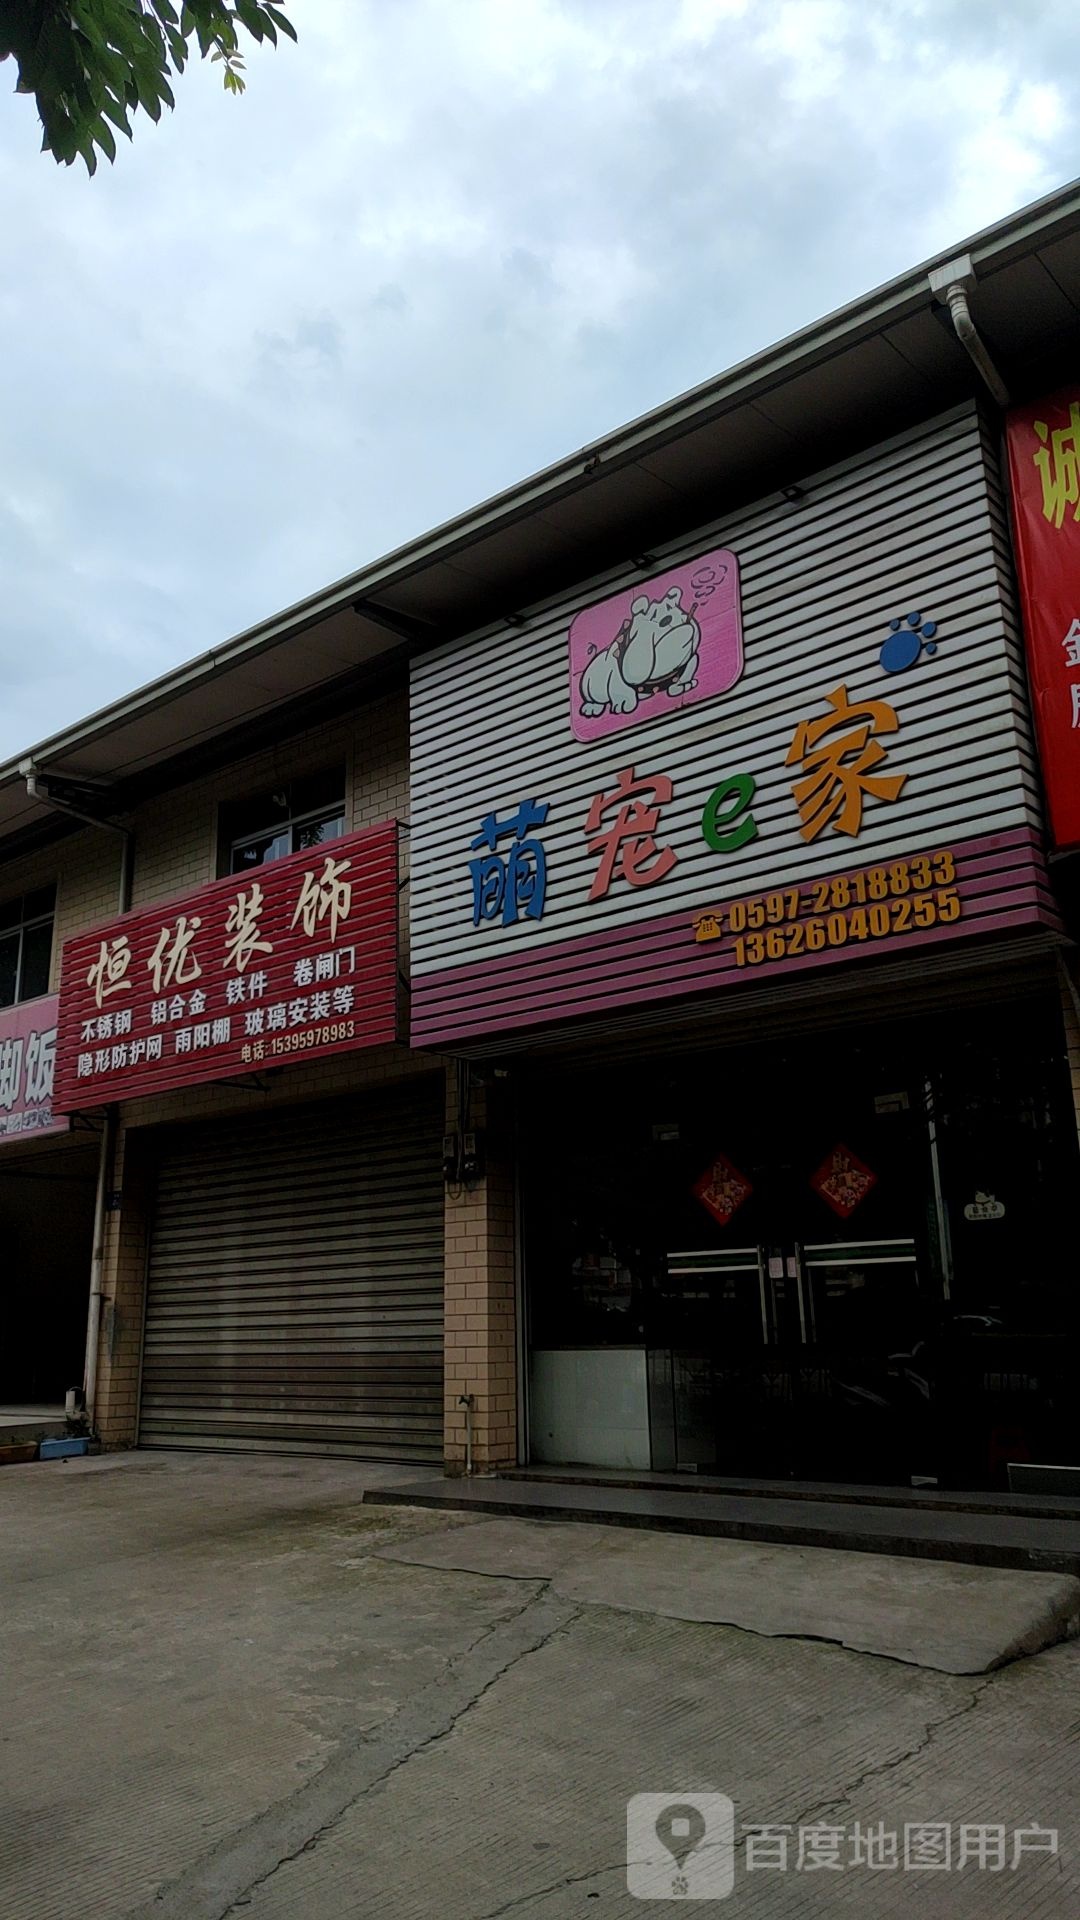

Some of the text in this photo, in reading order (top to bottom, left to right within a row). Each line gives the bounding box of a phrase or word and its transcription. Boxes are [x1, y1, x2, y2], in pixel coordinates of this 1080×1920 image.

[471, 684, 909, 928] 萌宠e家
[87, 857, 352, 1009] 恒优装饰
[729, 851, 956, 933] 0597-2818833
[733, 888, 961, 967] 13626040255
[77, 985, 355, 1078] 隐形防护网 雨阳棚 玻璃安装等
[80, 945, 356, 1043] 不锈钢 铝合金 铁件 卷闸门
